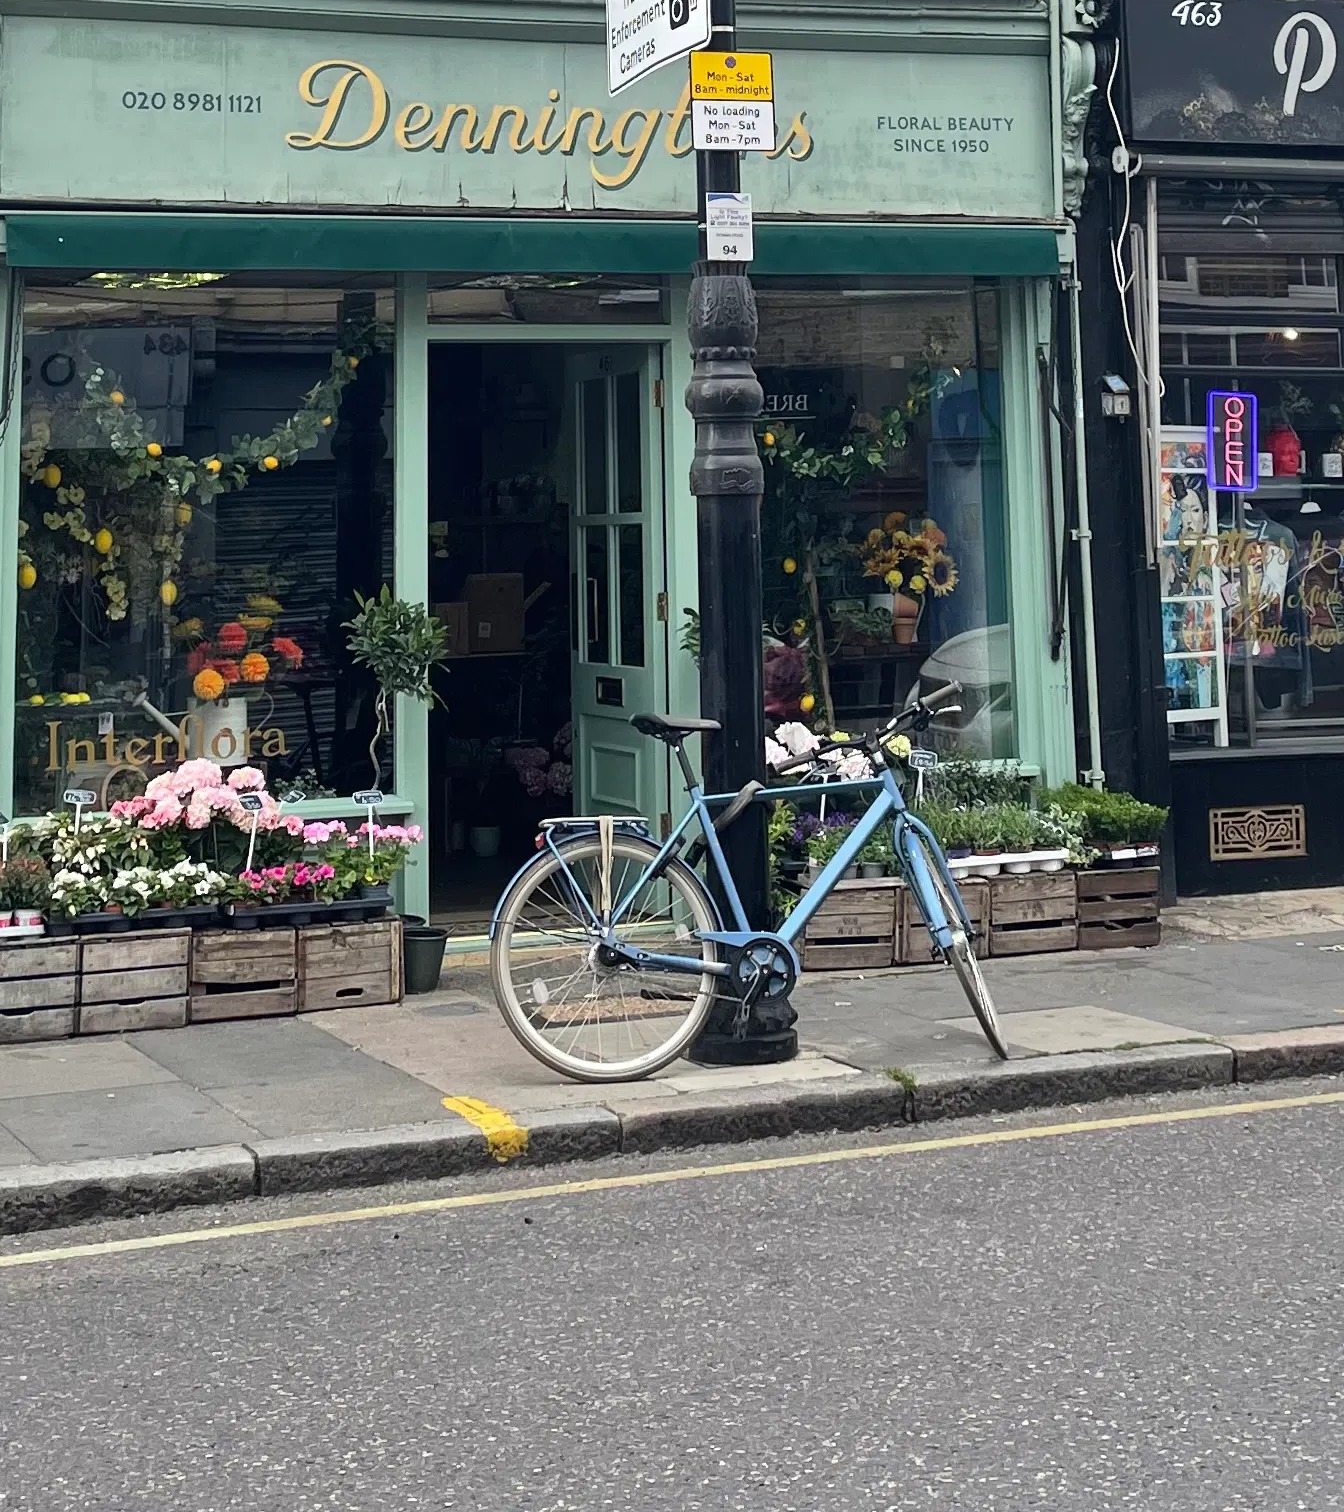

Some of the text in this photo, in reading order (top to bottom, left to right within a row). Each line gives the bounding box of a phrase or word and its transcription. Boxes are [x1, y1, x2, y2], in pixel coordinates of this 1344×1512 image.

[1171, 0, 1222, 27] 463
[619, 38, 656, 75] Cameras
[706, 71, 727, 82] Mon
[736, 72, 754, 82] Sat
[694, 84, 717, 94] 8am
[726, 85, 770, 96] midnight
[122, 91, 262, 114] 020 8981 1121
[703, 105, 760, 118] No loading
[284, 59, 815, 190] Denningts
[708, 120, 730, 130] Mon
[738, 120, 756, 131] Sat
[877, 116, 1014, 131] FLORAL BEAUTY
[894, 138, 989, 153] SINCE 1950
[722, 245, 738, 255] 94
[1224, 396, 1245, 487] OPEN
[44, 714, 291, 773] Interflora
